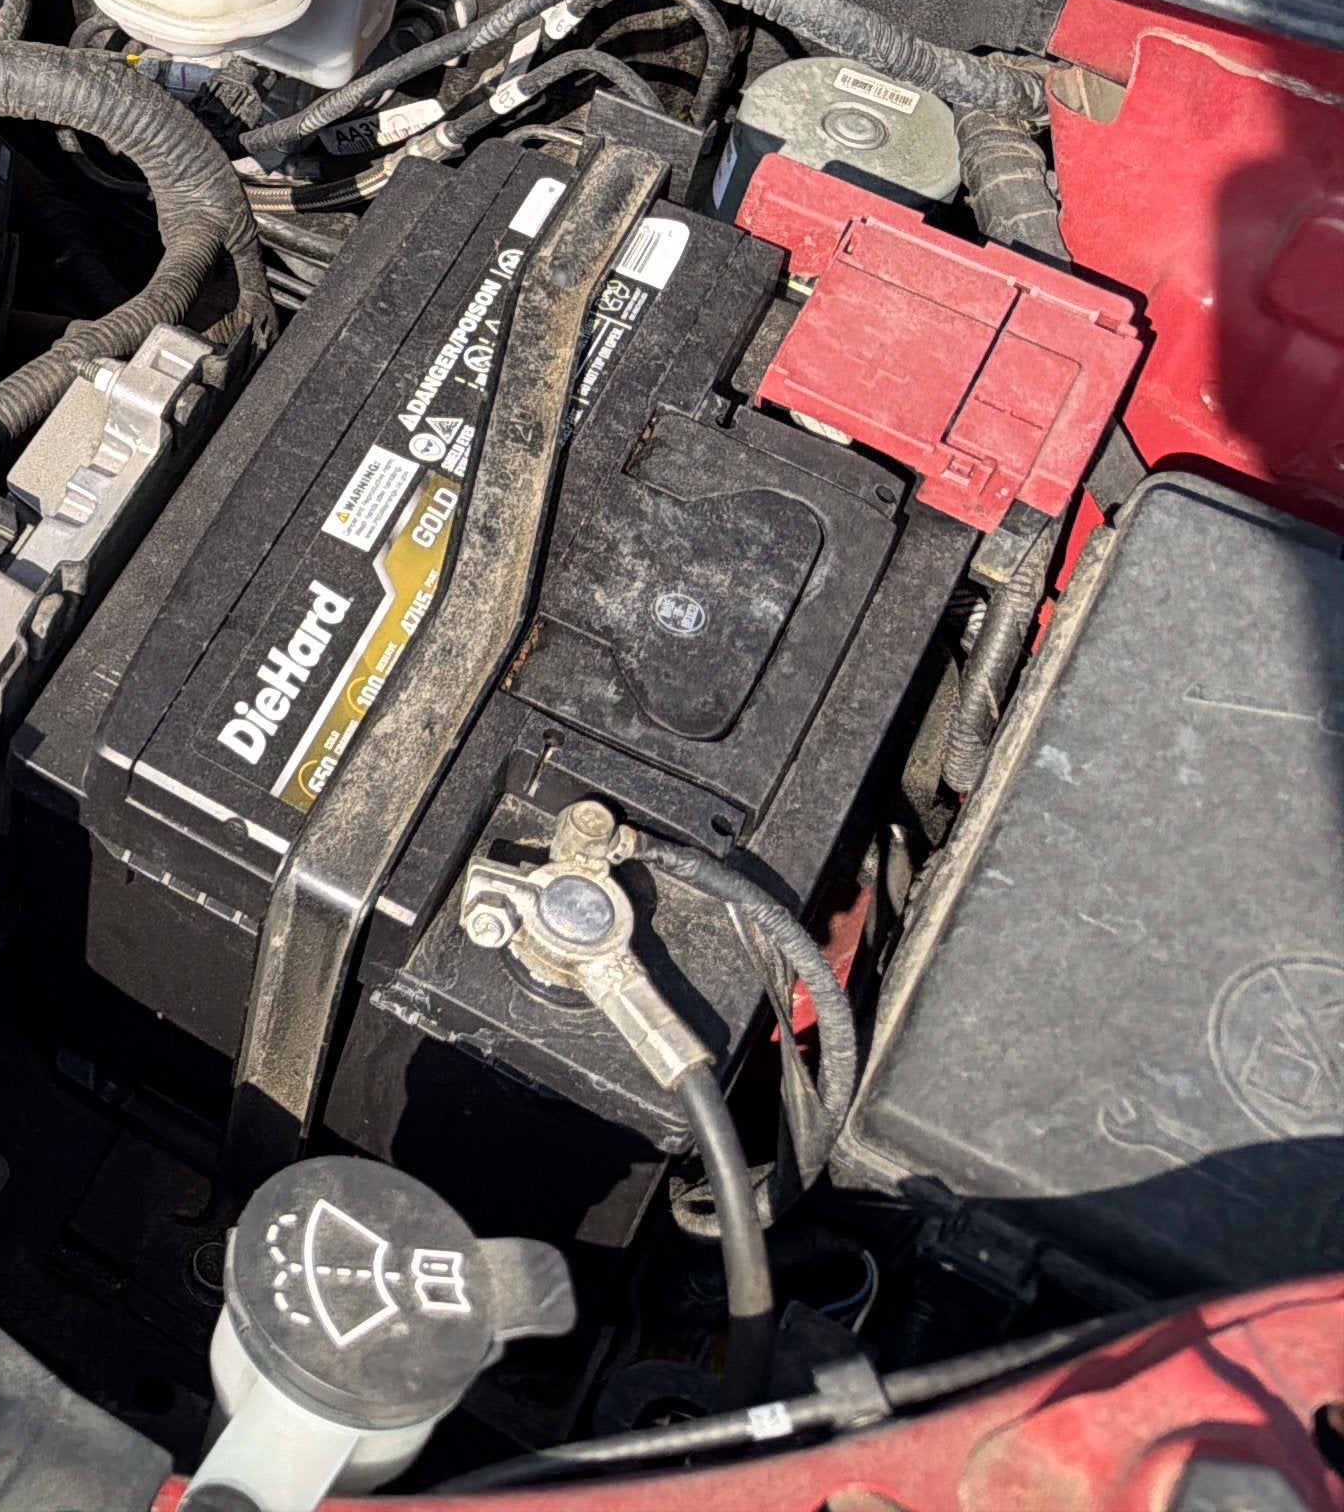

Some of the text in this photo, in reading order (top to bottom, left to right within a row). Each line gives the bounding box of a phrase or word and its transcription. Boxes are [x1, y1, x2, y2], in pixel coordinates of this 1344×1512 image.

[408, 280, 499, 414] DANGER/POISON
[584, 369, 598, 385] NOT
[591, 357, 604, 370] TIP
[598, 347, 612, 359] OR
[344, 462, 379, 510] WARNING:
[413, 488, 457, 546] GOLD
[221, 583, 347, 761] DieHard
